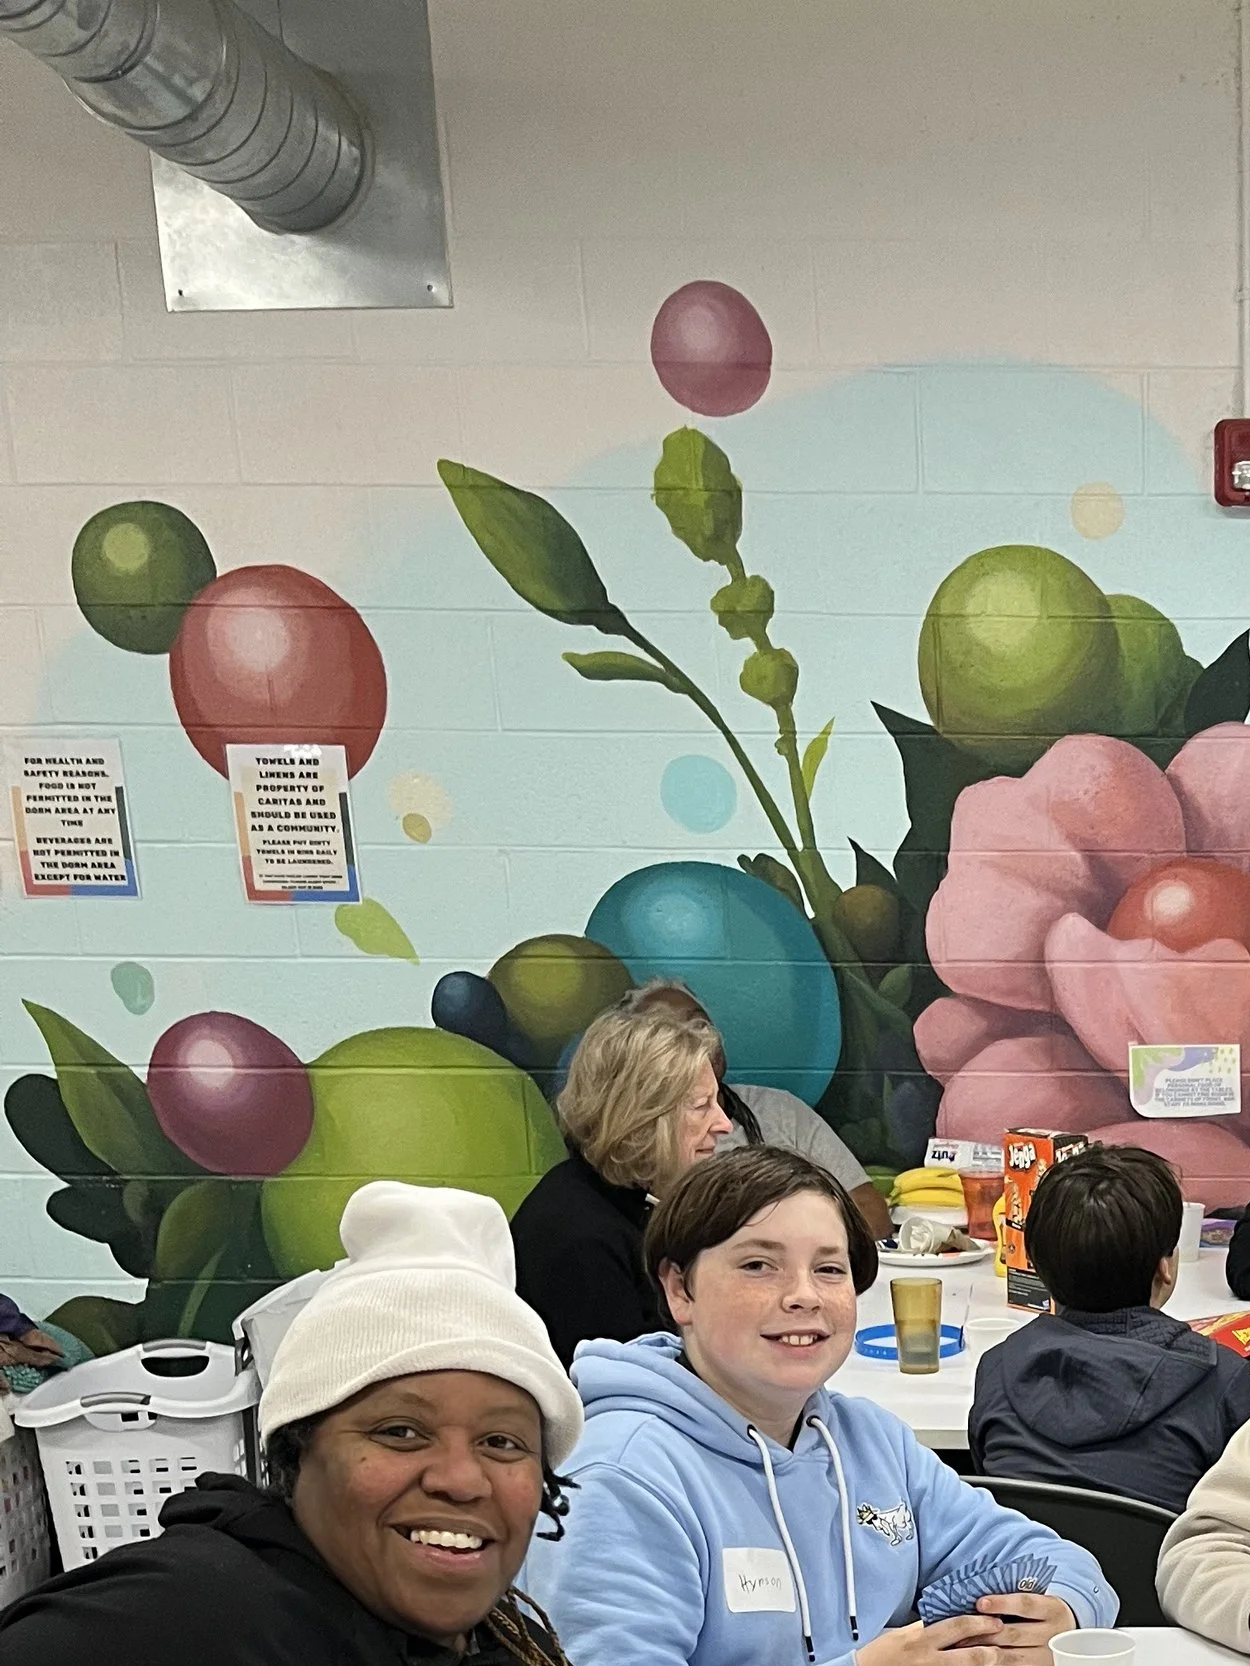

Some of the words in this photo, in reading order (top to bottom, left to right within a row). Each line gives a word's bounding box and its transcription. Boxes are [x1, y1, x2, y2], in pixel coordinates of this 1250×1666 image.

[299, 758, 319, 766] AND
[258, 798, 302, 806] CARITAS
[306, 798, 326, 806] AND
[1009, 1141, 1037, 1170] Jenga
